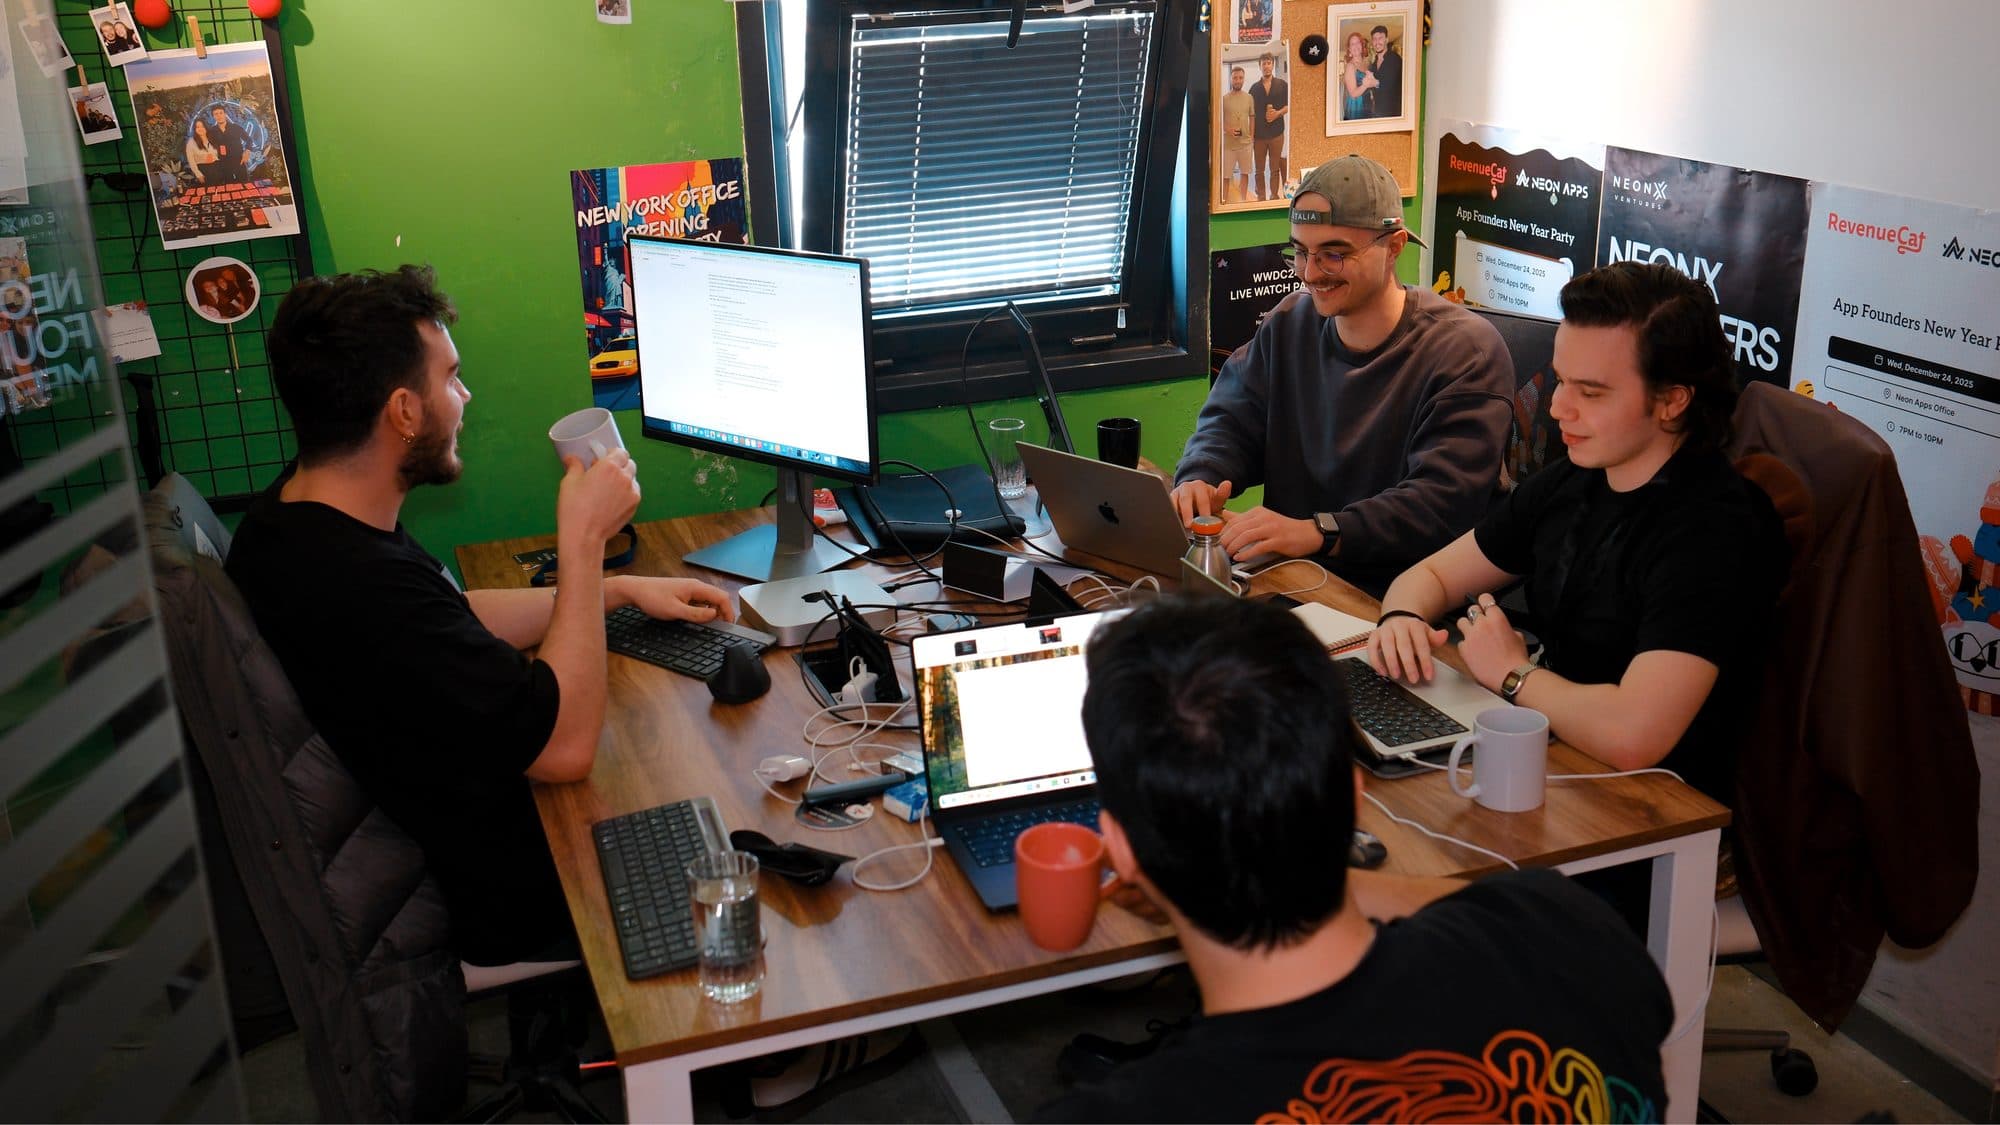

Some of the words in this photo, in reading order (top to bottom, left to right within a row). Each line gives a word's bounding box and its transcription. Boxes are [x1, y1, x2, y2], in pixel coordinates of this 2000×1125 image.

[1449, 155, 1507, 184] RevenueCat
[1531, 177, 1560, 193] NEON
[1563, 182, 1589, 199] APPS
[577, 202, 621, 227] NEW
[623, 192, 675, 220] YORK
[677, 180, 740, 208] OFFICE
[1456, 206, 1472, 222] App
[1473, 210, 1508, 230] Founders
[1509, 218, 1529, 234] New
[1530, 223, 1550, 239] Year
[1550, 228, 1575, 247] Party
[1827, 212, 1926, 255] RevenueCat
[1498, 258, 1522, 272] December
[1532, 268, 1546, 278] 2025
[1969, 247, 2000, 268] NEO
[1253, 268, 1298, 284] WWDC2
[1493, 274, 1505, 284] Neon
[1506, 278, 1519, 289] Apps
[1520, 282, 1535, 293] Office
[1230, 284, 1252, 301] LIVE
[1254, 282, 1291, 297] WATCH
[1293, 281, 1306, 292] PA
[1497, 292, 1508, 302] 7PM
[1833, 297, 1859, 318] App
[1861, 303, 1920, 331] Founders
[1923, 318, 1957, 339] New
[1960, 327, 1992, 348] Year
[1905, 364, 1941, 379] December
[1954, 376, 1974, 389] 2025
[1896, 393, 1914, 405] Neon
[1914, 398, 1932, 410] Apps
[1933, 404, 1955, 417] Office
[1899, 425, 1914, 438] 7PM
[1915, 430, 1922, 440] to
[1924, 433, 1944, 445] 10PM
